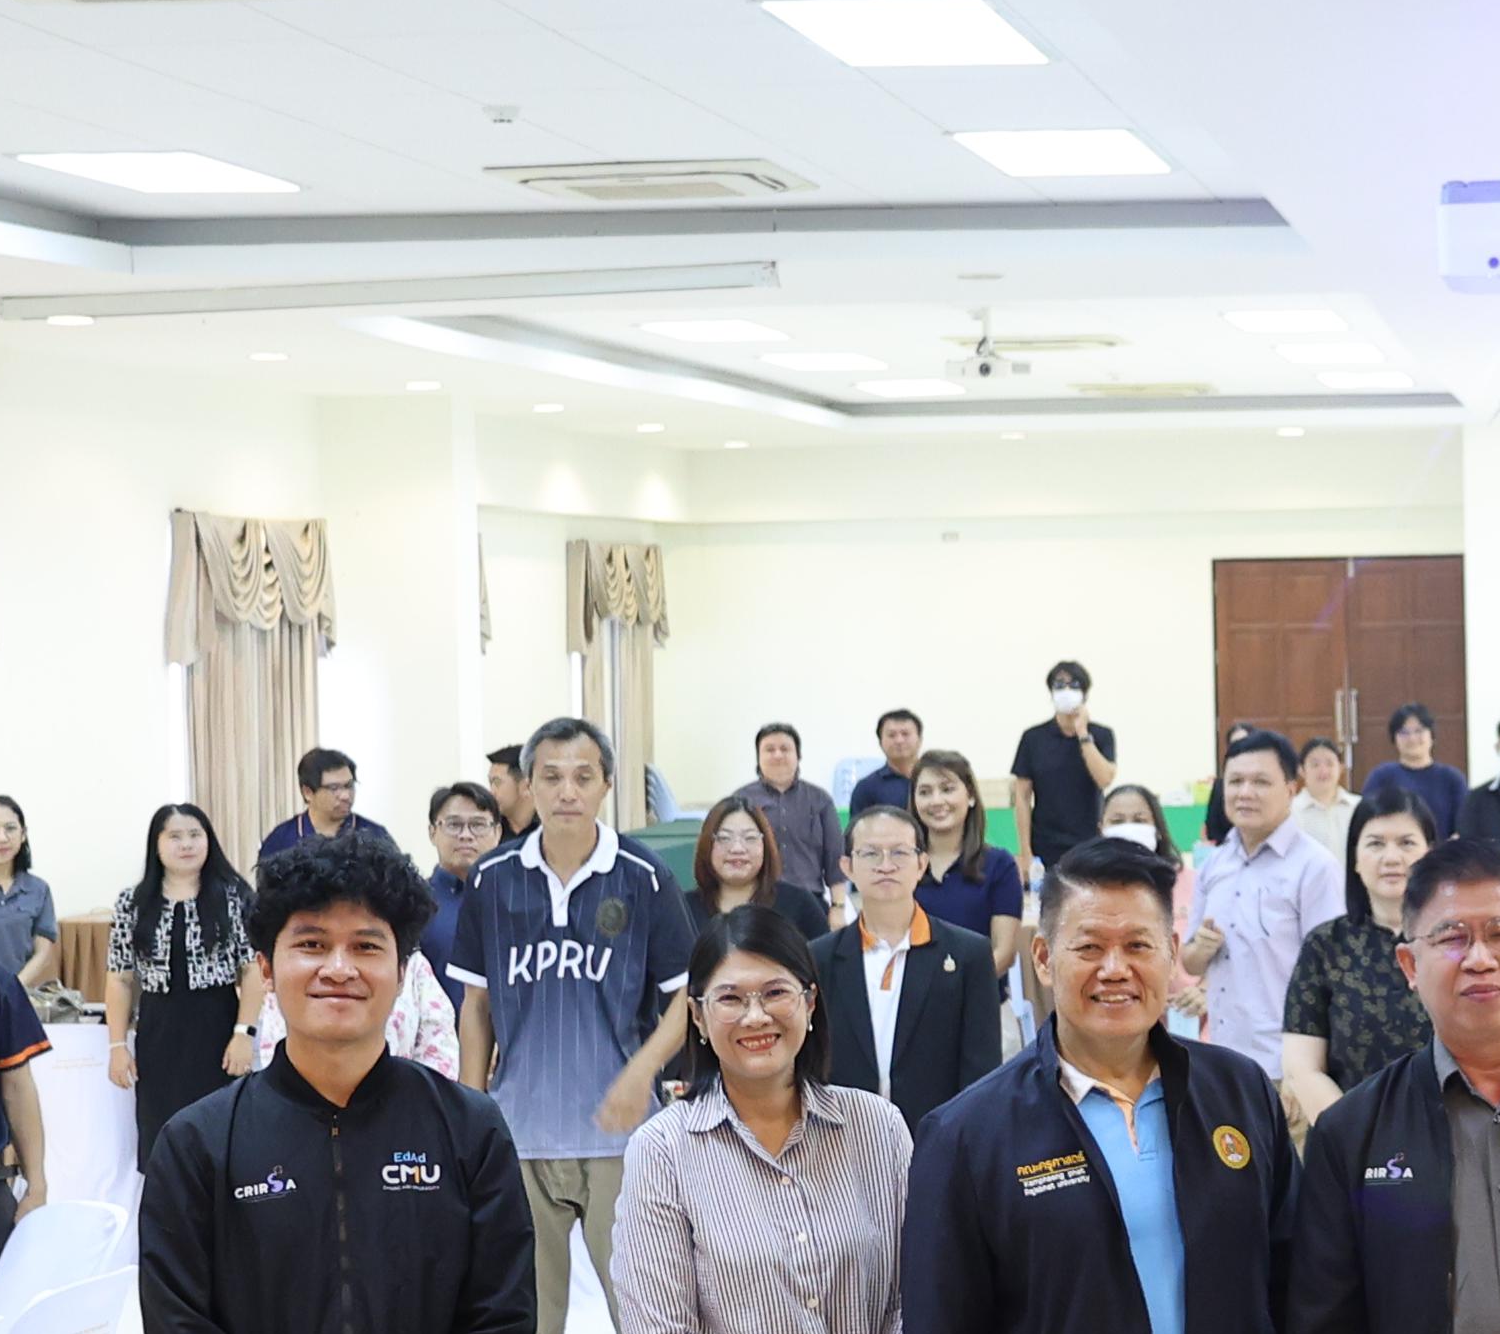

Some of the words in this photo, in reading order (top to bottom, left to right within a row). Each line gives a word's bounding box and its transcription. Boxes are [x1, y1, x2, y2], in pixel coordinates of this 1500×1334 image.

[508, 939, 612, 986] KPRU
[393, 1151, 427, 1164] EdAd
[1364, 1157, 1414, 1179] RIRSA
[234, 1171, 297, 1199] CRIRSA
[381, 1164, 441, 1184] CMU
